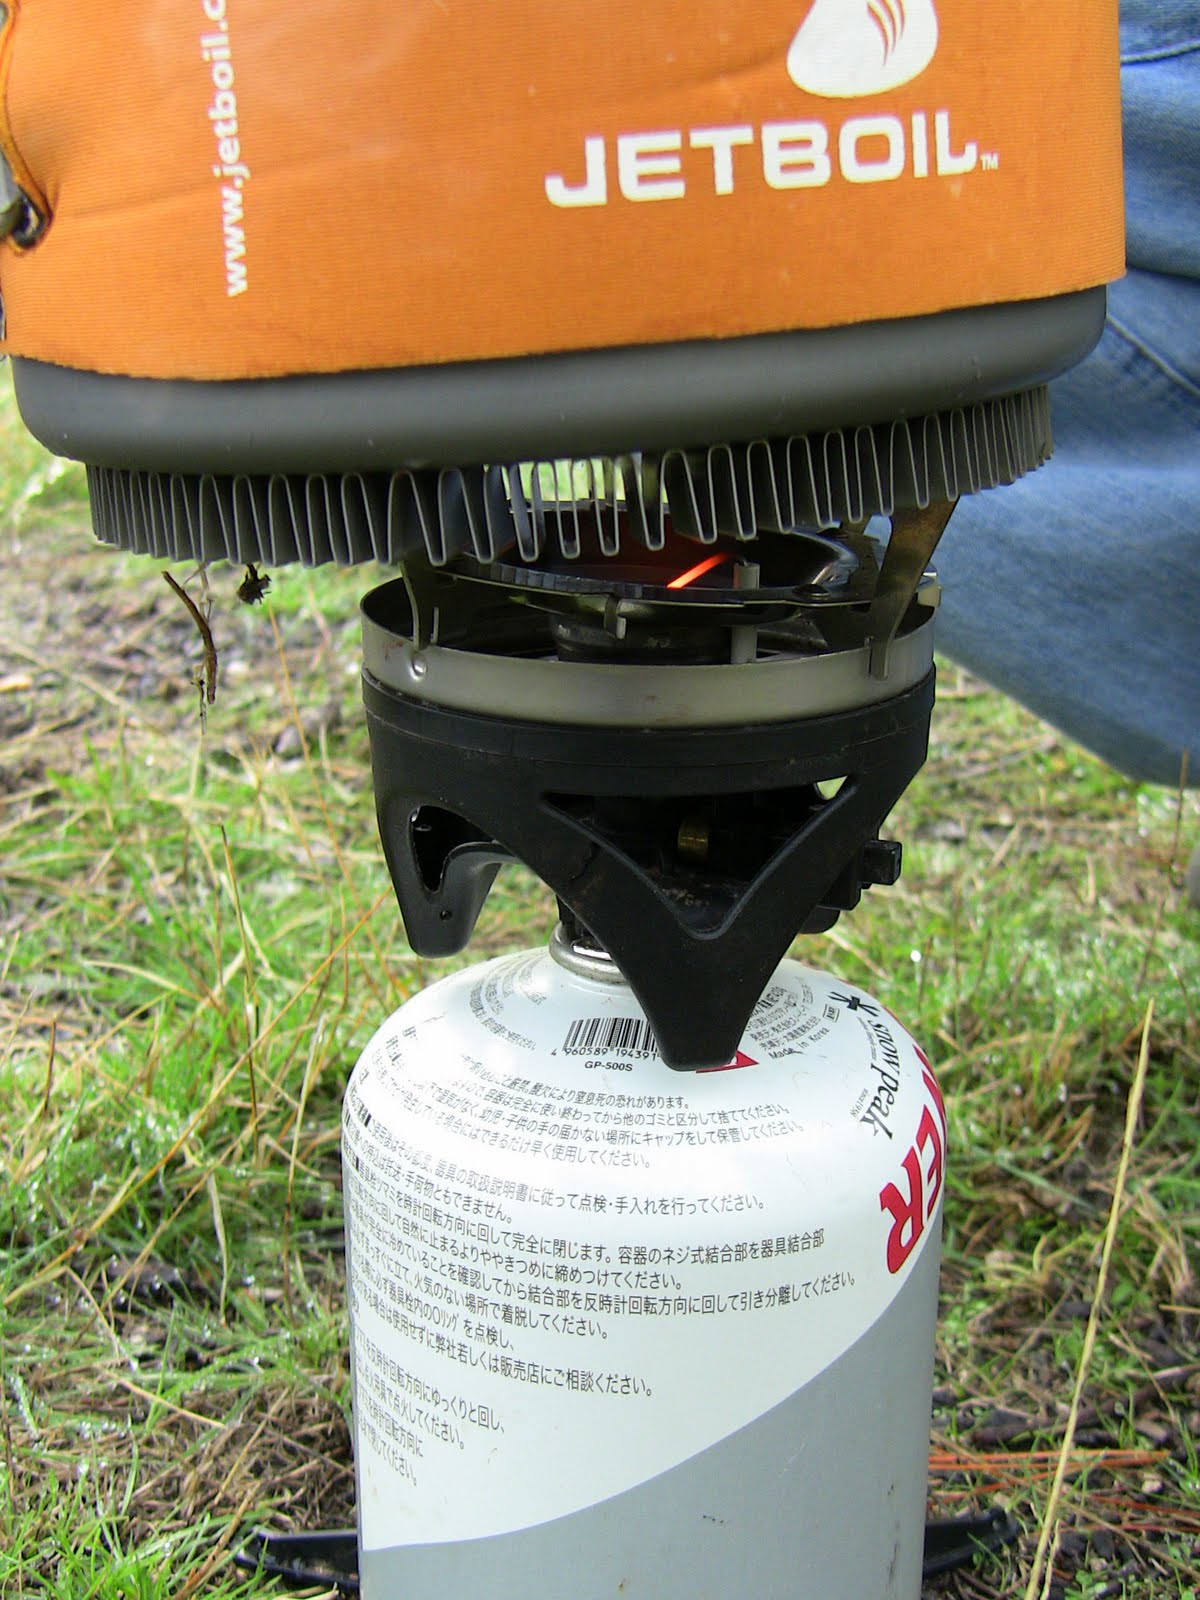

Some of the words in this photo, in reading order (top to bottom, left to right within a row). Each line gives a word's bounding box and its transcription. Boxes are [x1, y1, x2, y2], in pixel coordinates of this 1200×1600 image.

[545, 110, 978, 207] JETBOIL
[565, 1047, 607, 1057] 960589
[768, 1048, 794, 1059] Made
[867, 1019, 900, 1074] snow
[584, 1060, 633, 1072] GP-500S
[860, 1062, 899, 1139] peak
